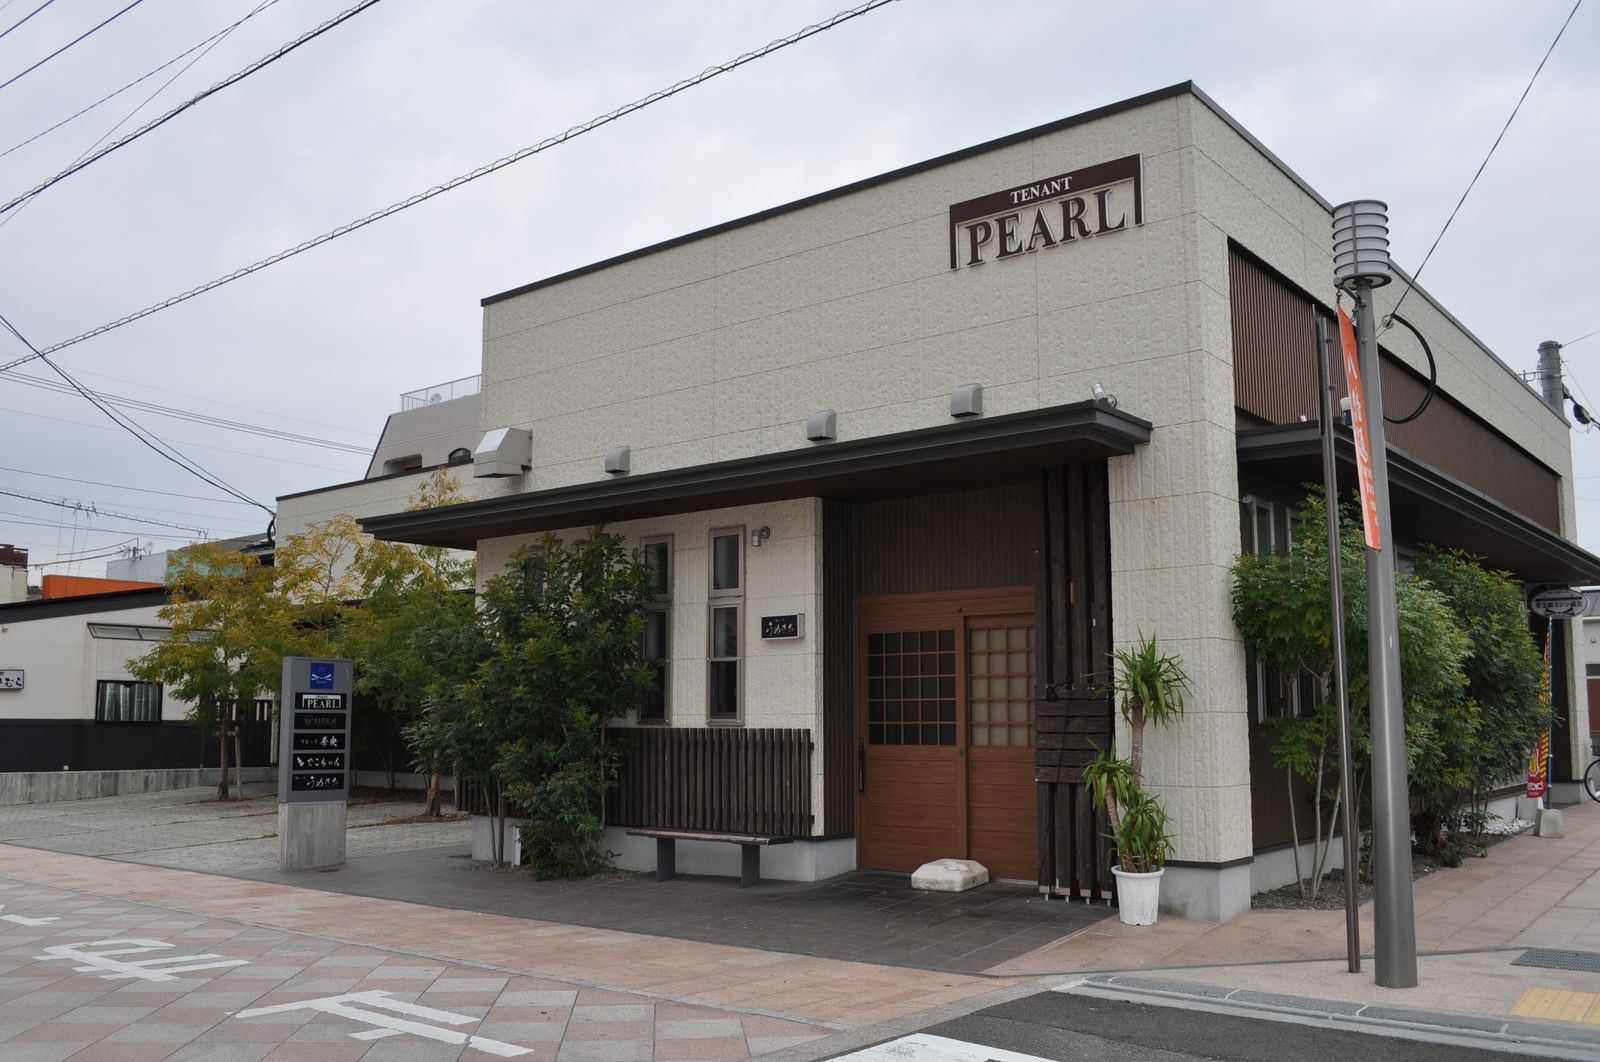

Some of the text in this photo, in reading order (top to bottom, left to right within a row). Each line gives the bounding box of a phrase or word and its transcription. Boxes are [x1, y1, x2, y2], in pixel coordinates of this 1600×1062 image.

[1009, 176, 1073, 205] TENANT
[965, 188, 1128, 267] PEARL
[307, 699, 339, 709] PEARL
[306, 757, 340, 767] でこちゃん
